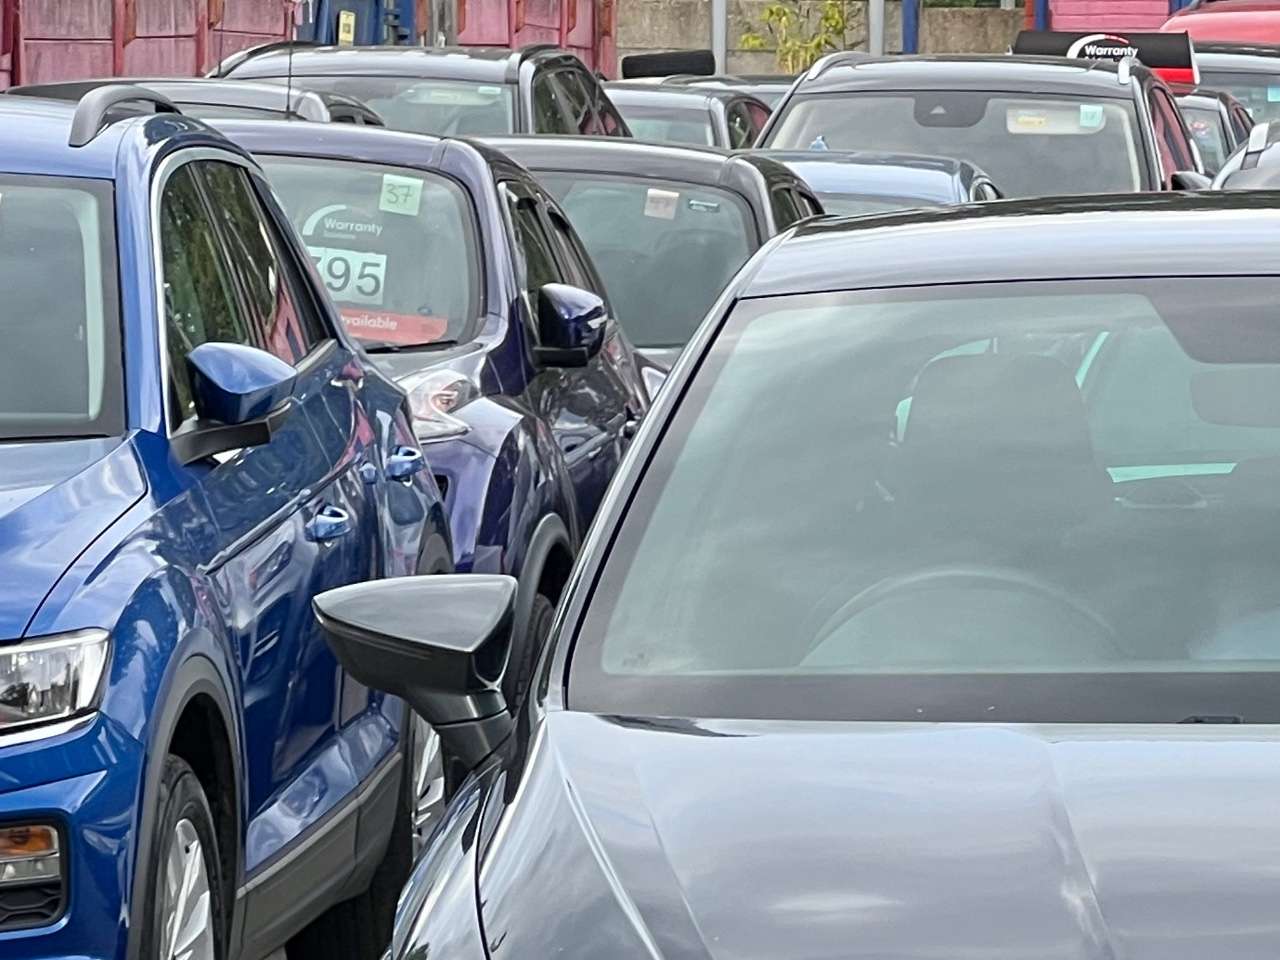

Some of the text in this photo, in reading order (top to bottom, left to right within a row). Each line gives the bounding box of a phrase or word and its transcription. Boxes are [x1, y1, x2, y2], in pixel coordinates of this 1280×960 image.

[1085, 45, 1138, 58] Warranty
[386, 183, 414, 204] 37
[323, 217, 383, 235] Warranty
[340, 313, 398, 330] vailable
